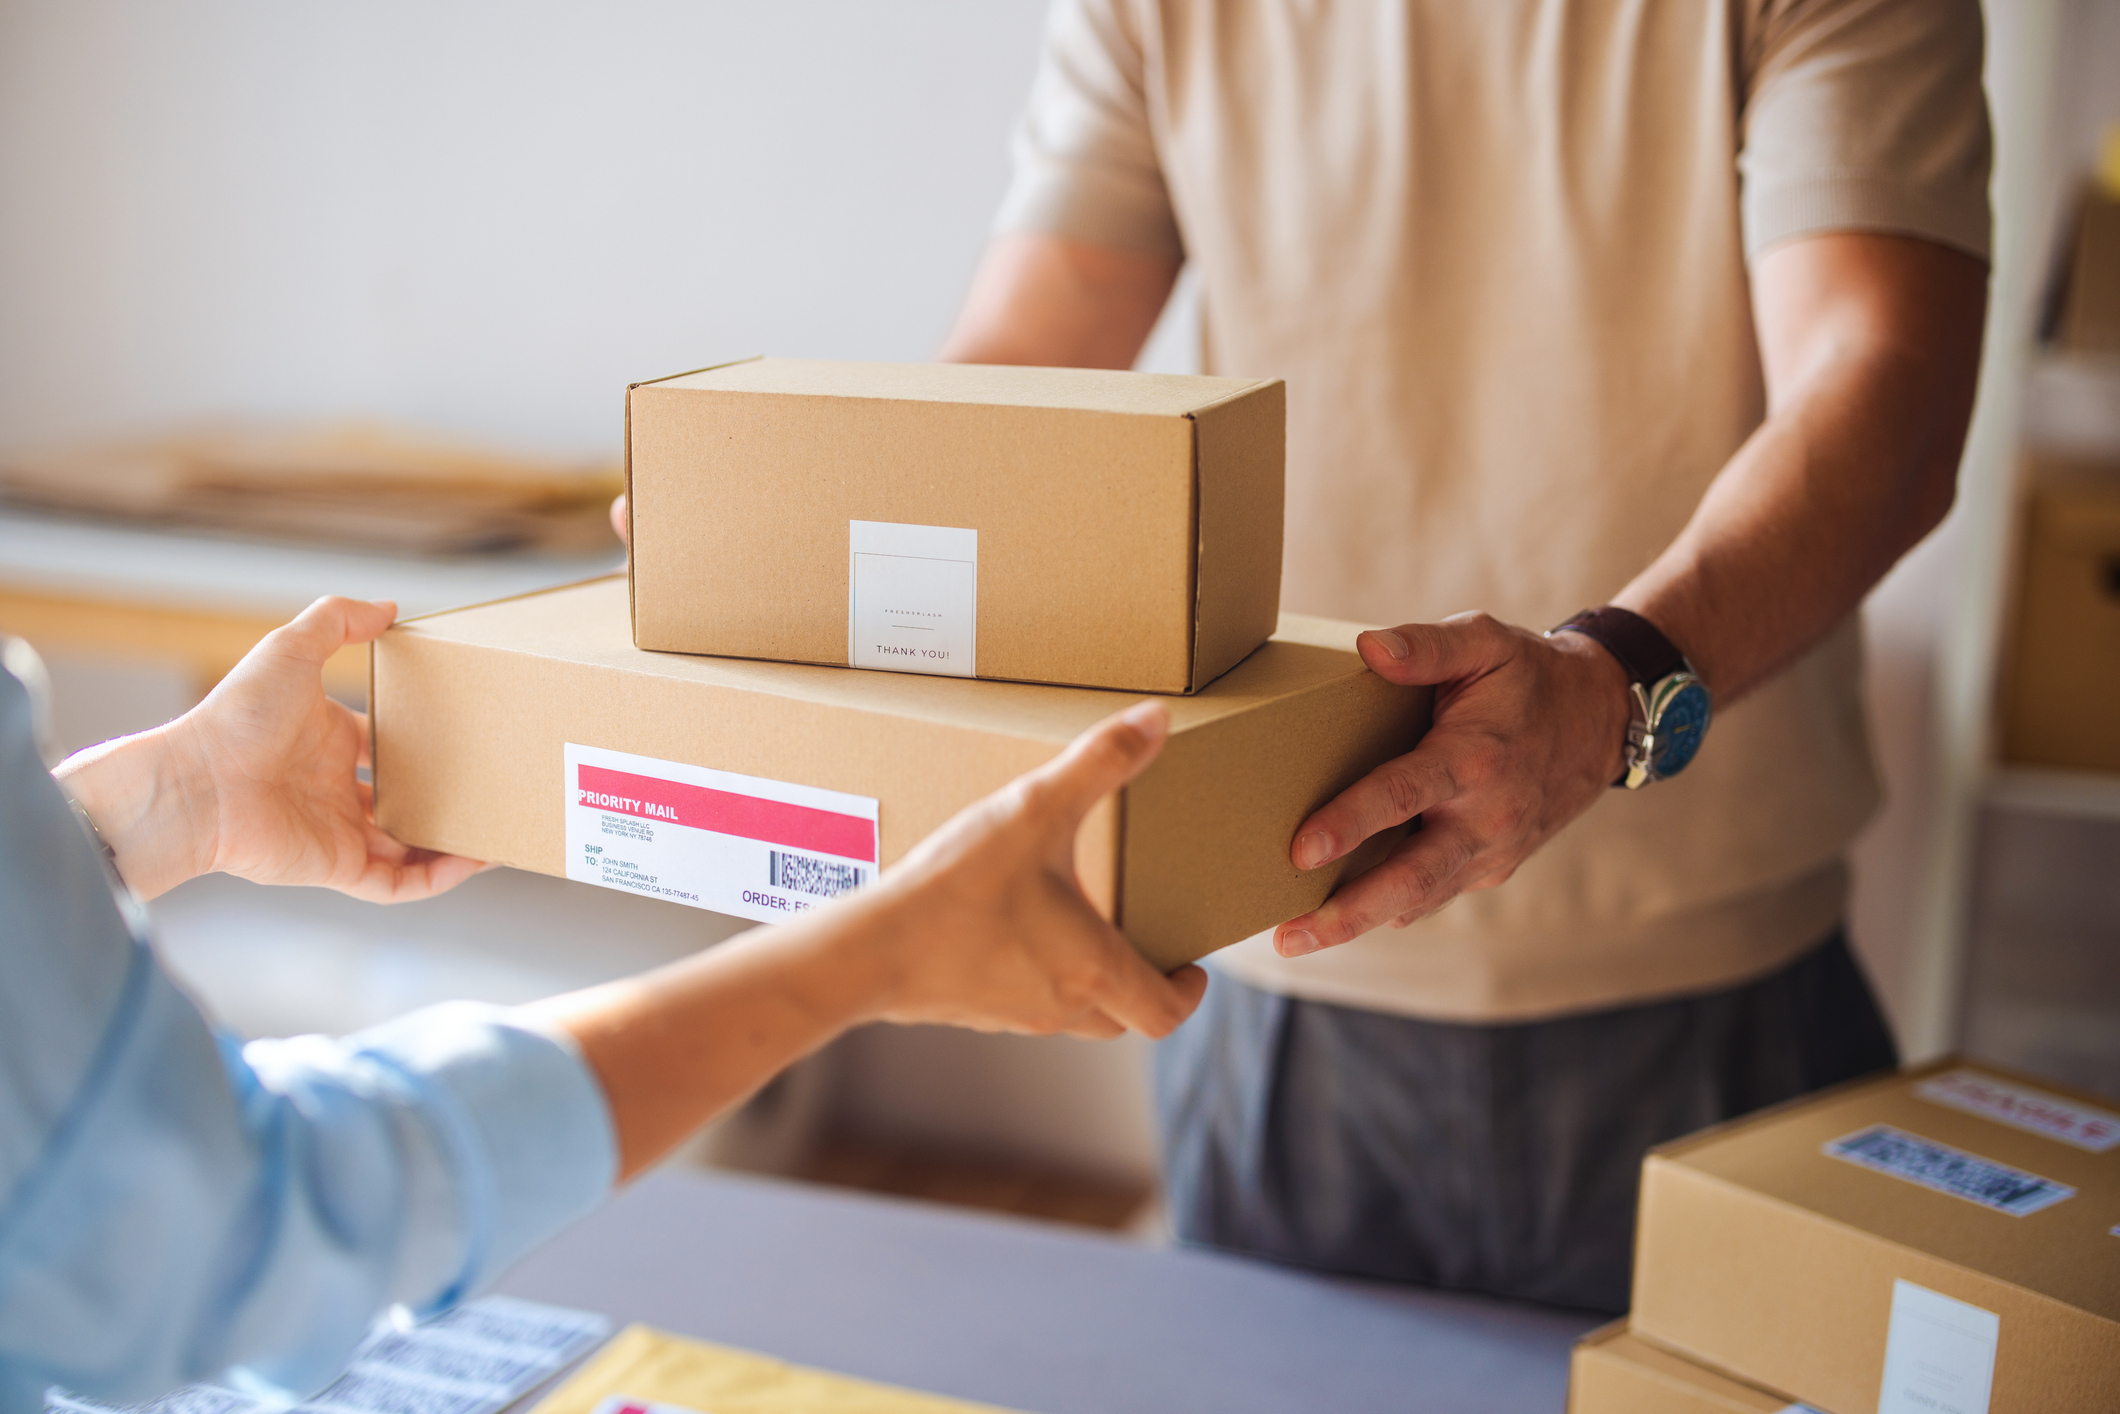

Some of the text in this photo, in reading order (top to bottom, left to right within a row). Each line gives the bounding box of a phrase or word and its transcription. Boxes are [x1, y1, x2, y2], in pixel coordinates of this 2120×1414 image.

[876, 645, 950, 660] THANK YOU!
[579, 789, 679, 820] PRIORITY MAIL
[601, 814, 651, 830] FRESH SPLASH LLC
[601, 820, 655, 837] BUSINESS VENUE RD
[601, 827, 614, 835] NEW
[615, 830, 629, 838] YORK
[584, 844, 603, 855] SHIP
[585, 855, 599, 867] TO:
[602, 857, 638, 870] JOHN SMITH
[602, 866, 658, 884] 124 CALIFORNIA ST
[601, 875, 615, 884] SAN
[615, 877, 650, 891] FRANCISCO
[651, 885, 661, 894] CA
[742, 890, 791, 911] ORDER:
